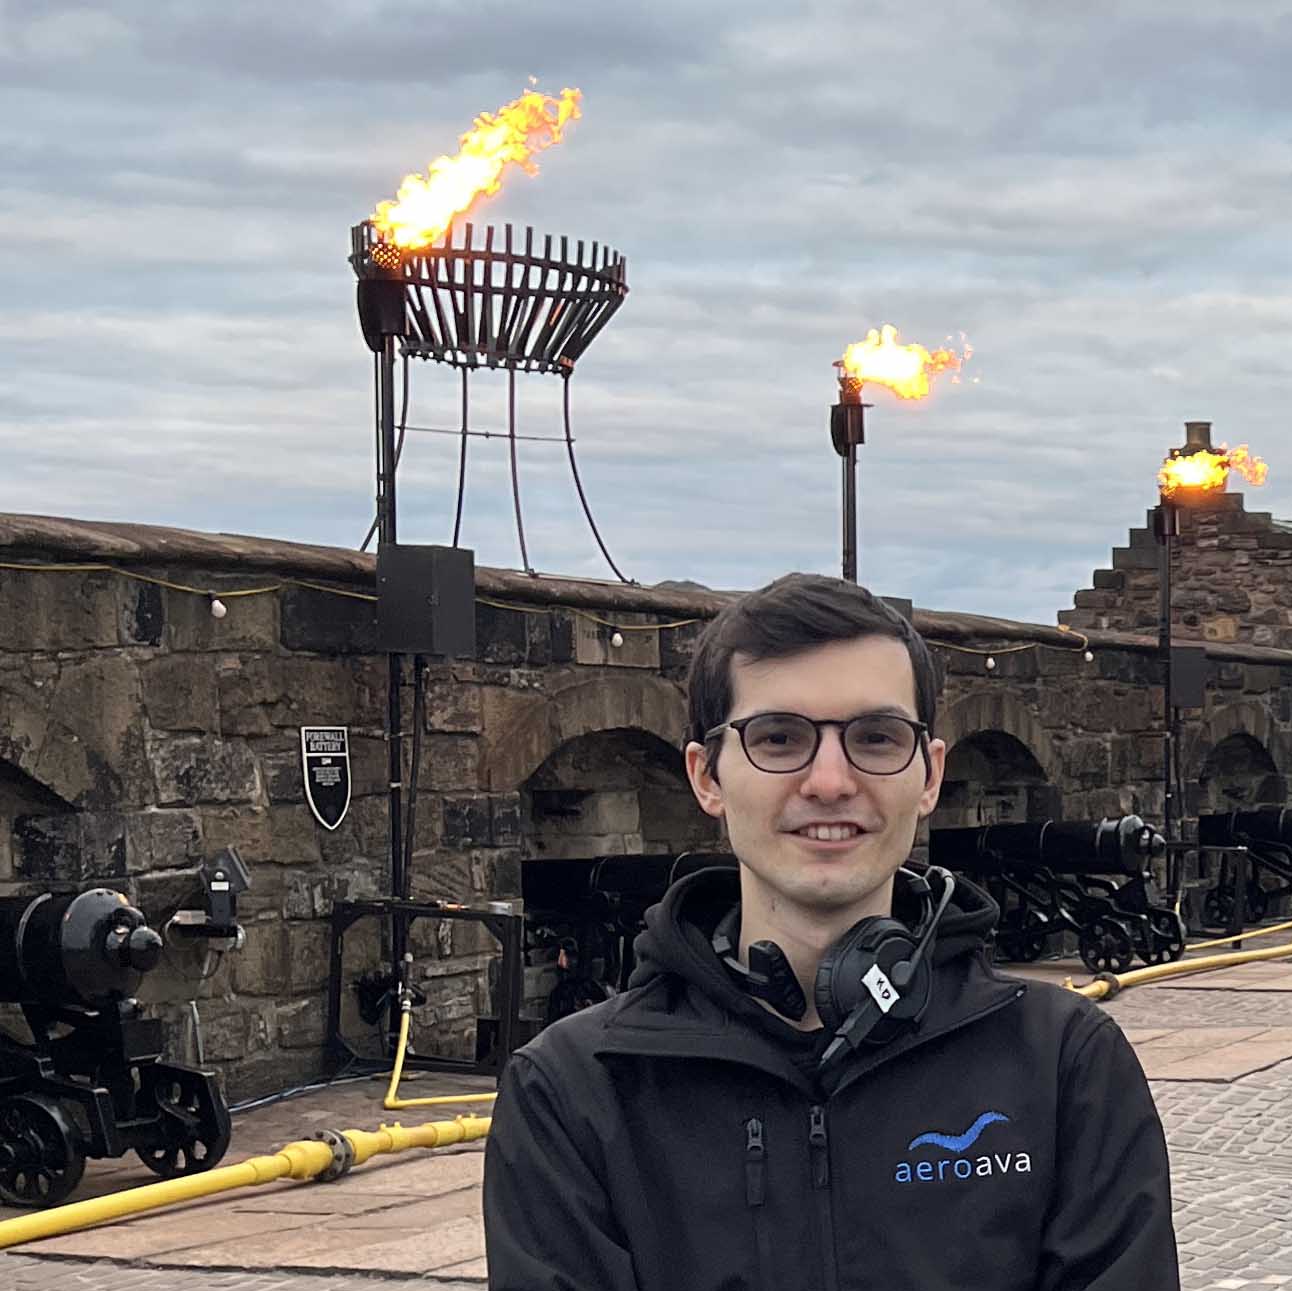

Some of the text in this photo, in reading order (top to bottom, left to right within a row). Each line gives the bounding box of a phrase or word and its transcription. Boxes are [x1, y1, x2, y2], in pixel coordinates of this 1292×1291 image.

[306, 731, 344, 741] FOREWALL
[310, 741, 341, 751] BATTERY
[895, 1151, 1032, 1183] aeroava
